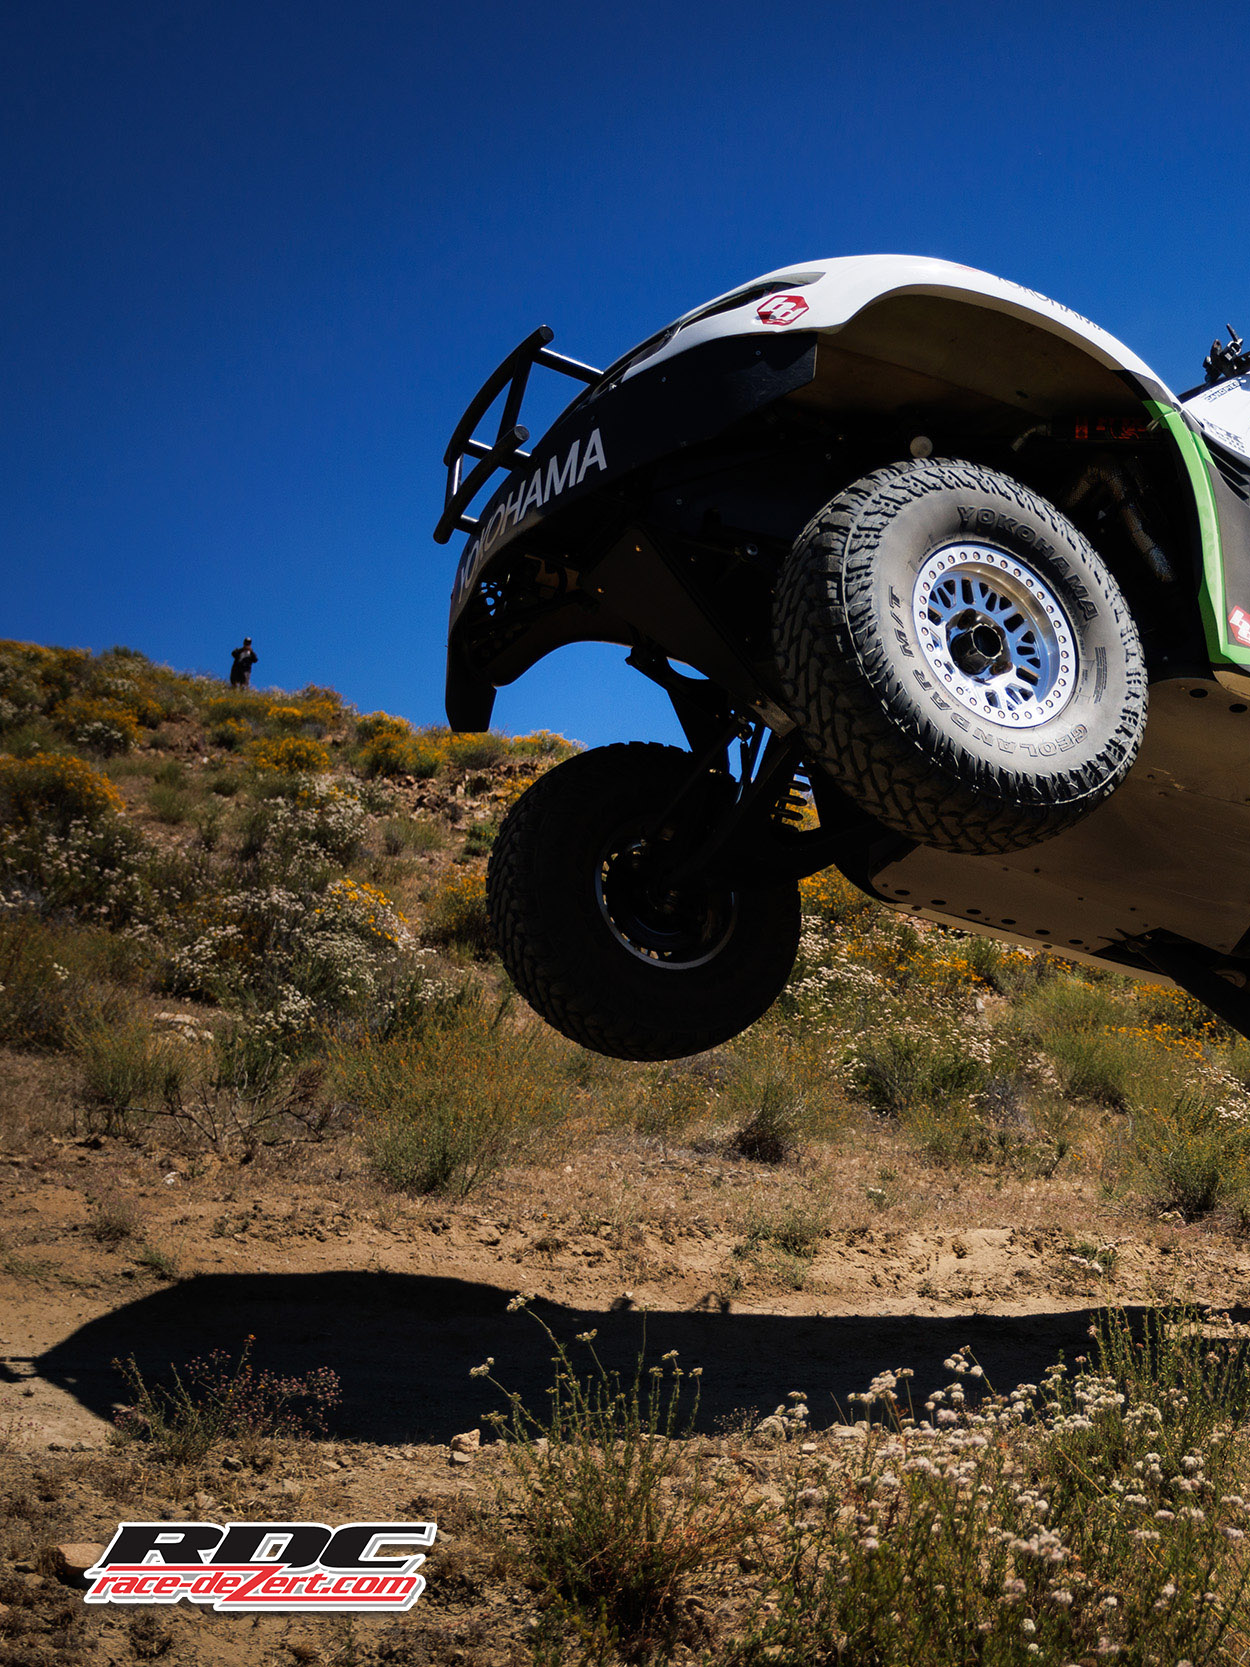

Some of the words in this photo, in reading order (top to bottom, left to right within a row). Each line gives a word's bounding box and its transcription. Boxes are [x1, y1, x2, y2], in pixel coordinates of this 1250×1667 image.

[957, 505, 1099, 621] YOKOHAMA
[888, 584, 915, 659] M/T
[912, 668, 1089, 758] GEOLANDAR
